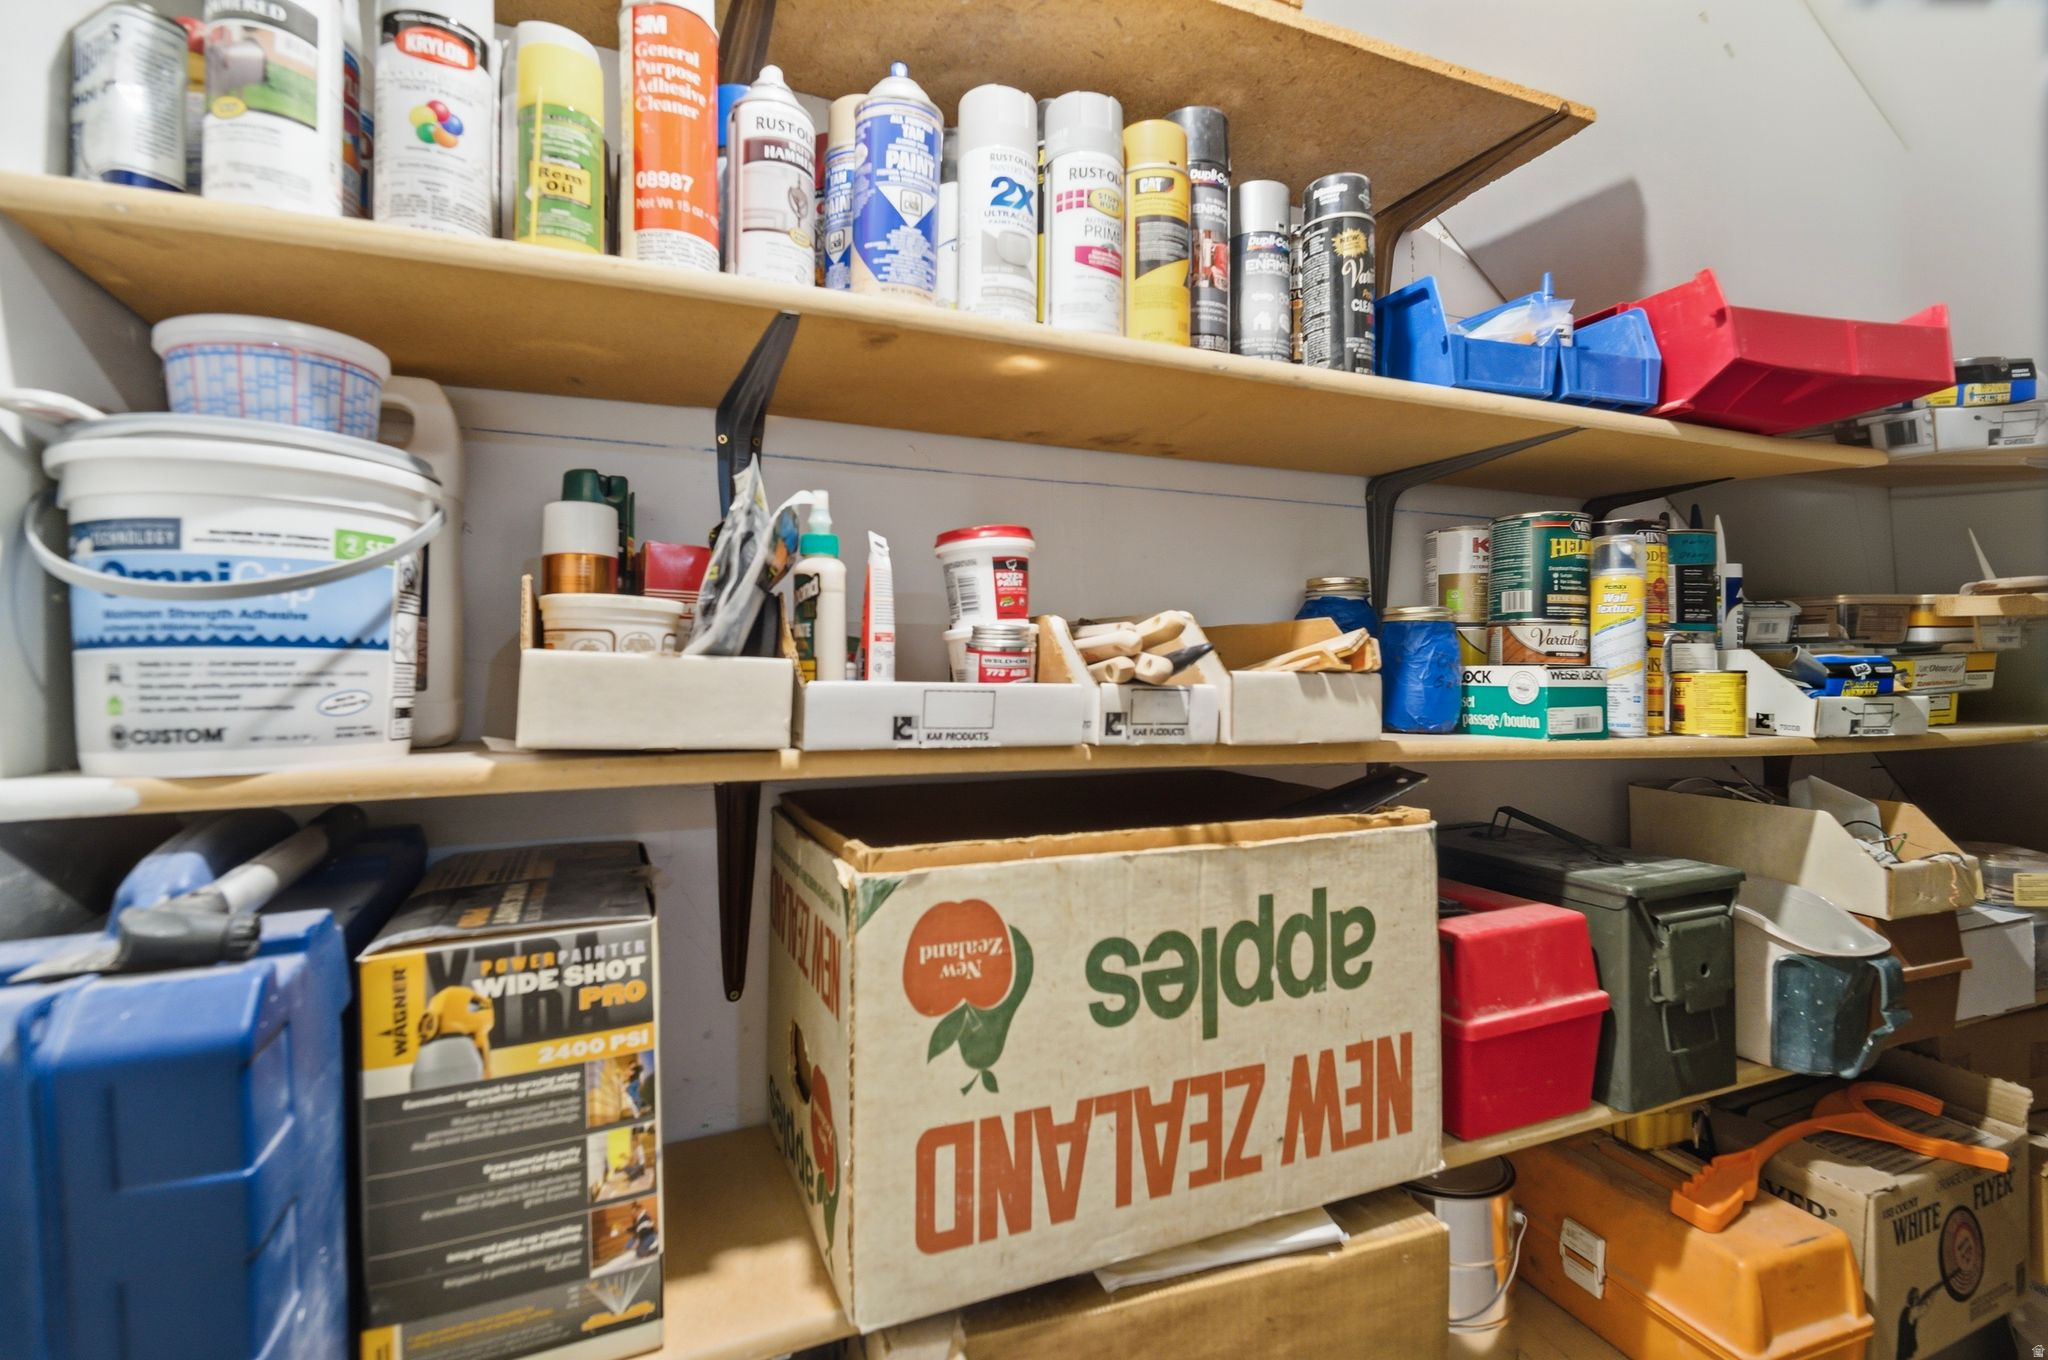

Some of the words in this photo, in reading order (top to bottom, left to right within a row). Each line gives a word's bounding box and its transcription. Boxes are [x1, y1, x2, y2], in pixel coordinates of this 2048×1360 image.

[635, 15, 667, 35] 3M
[635, 41, 700, 68] General
[636, 60, 702, 87] Purpose
[637, 77, 707, 108] Adhesive
[636, 96, 700, 120] Cleaner
[886, 150, 934, 181] PAINT
[546, 180, 574, 194] Oil
[636, 170, 694, 193] 08987
[1597, 604, 1636, 614] Texture
[1603, 593, 1628, 603] Wall
[168, 608, 233, 621] Strength
[239, 607, 309, 621] Adhesive
[130, 728, 226, 745] CUSTOM
[945, 732, 989, 741] PRODUCTS
[919, 937, 1004, 963] Zealand
[471, 968, 560, 999] WIDE
[563, 955, 648, 987] SHOT
[940, 958, 982, 980] New
[1085, 887, 1376, 1041] apples
[578, 979, 648, 1011] PRO
[391, 965, 409, 1058] WAGNER
[537, 1040, 606, 1064] 2400
[609, 1028, 649, 1051] PSI
[1280, 1031, 1414, 1166] NEW
[915, 1063, 1266, 1256] ZEALAND
[1972, 1165, 2014, 1211] FLYER
[1892, 1201, 1943, 1247] WHITE
